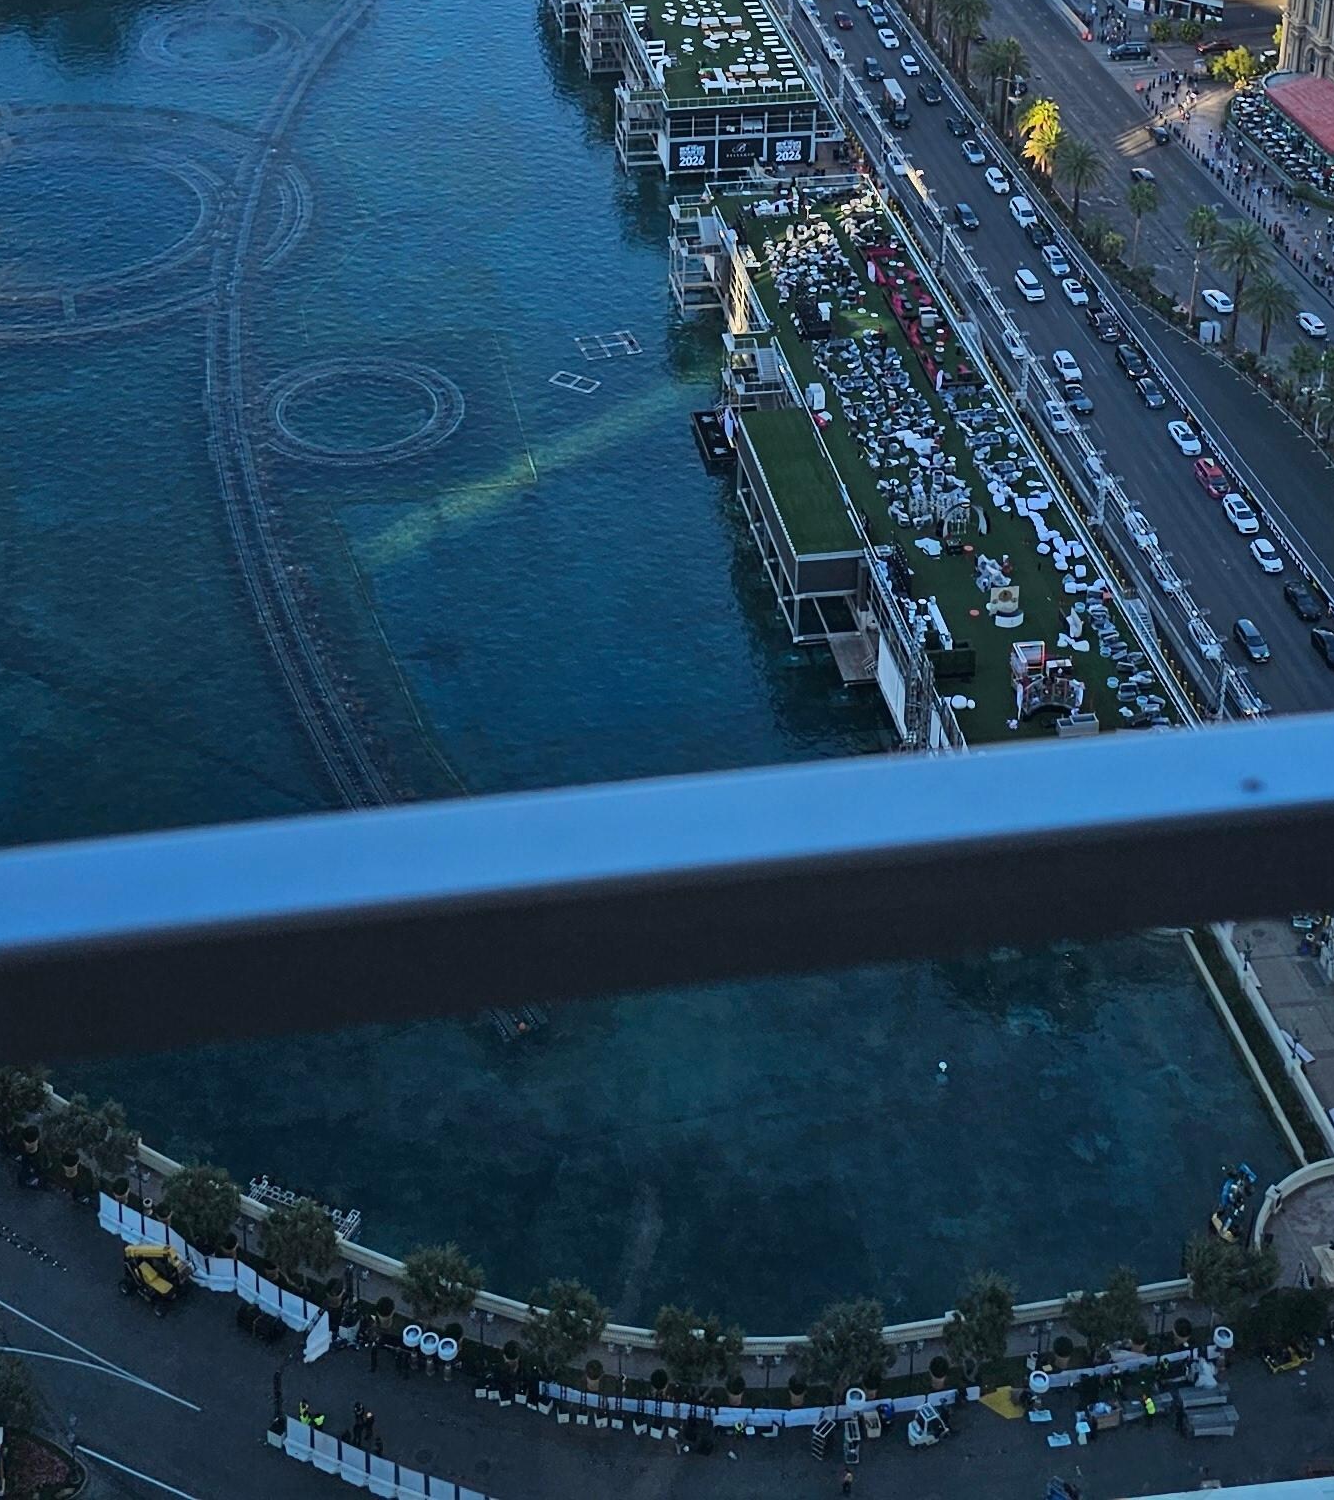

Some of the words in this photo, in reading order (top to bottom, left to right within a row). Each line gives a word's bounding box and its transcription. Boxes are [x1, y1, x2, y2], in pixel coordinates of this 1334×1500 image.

[678, 155, 706, 167] 2026
[775, 150, 802, 162] 2026
[1260, 511, 1311, 581] Globant
